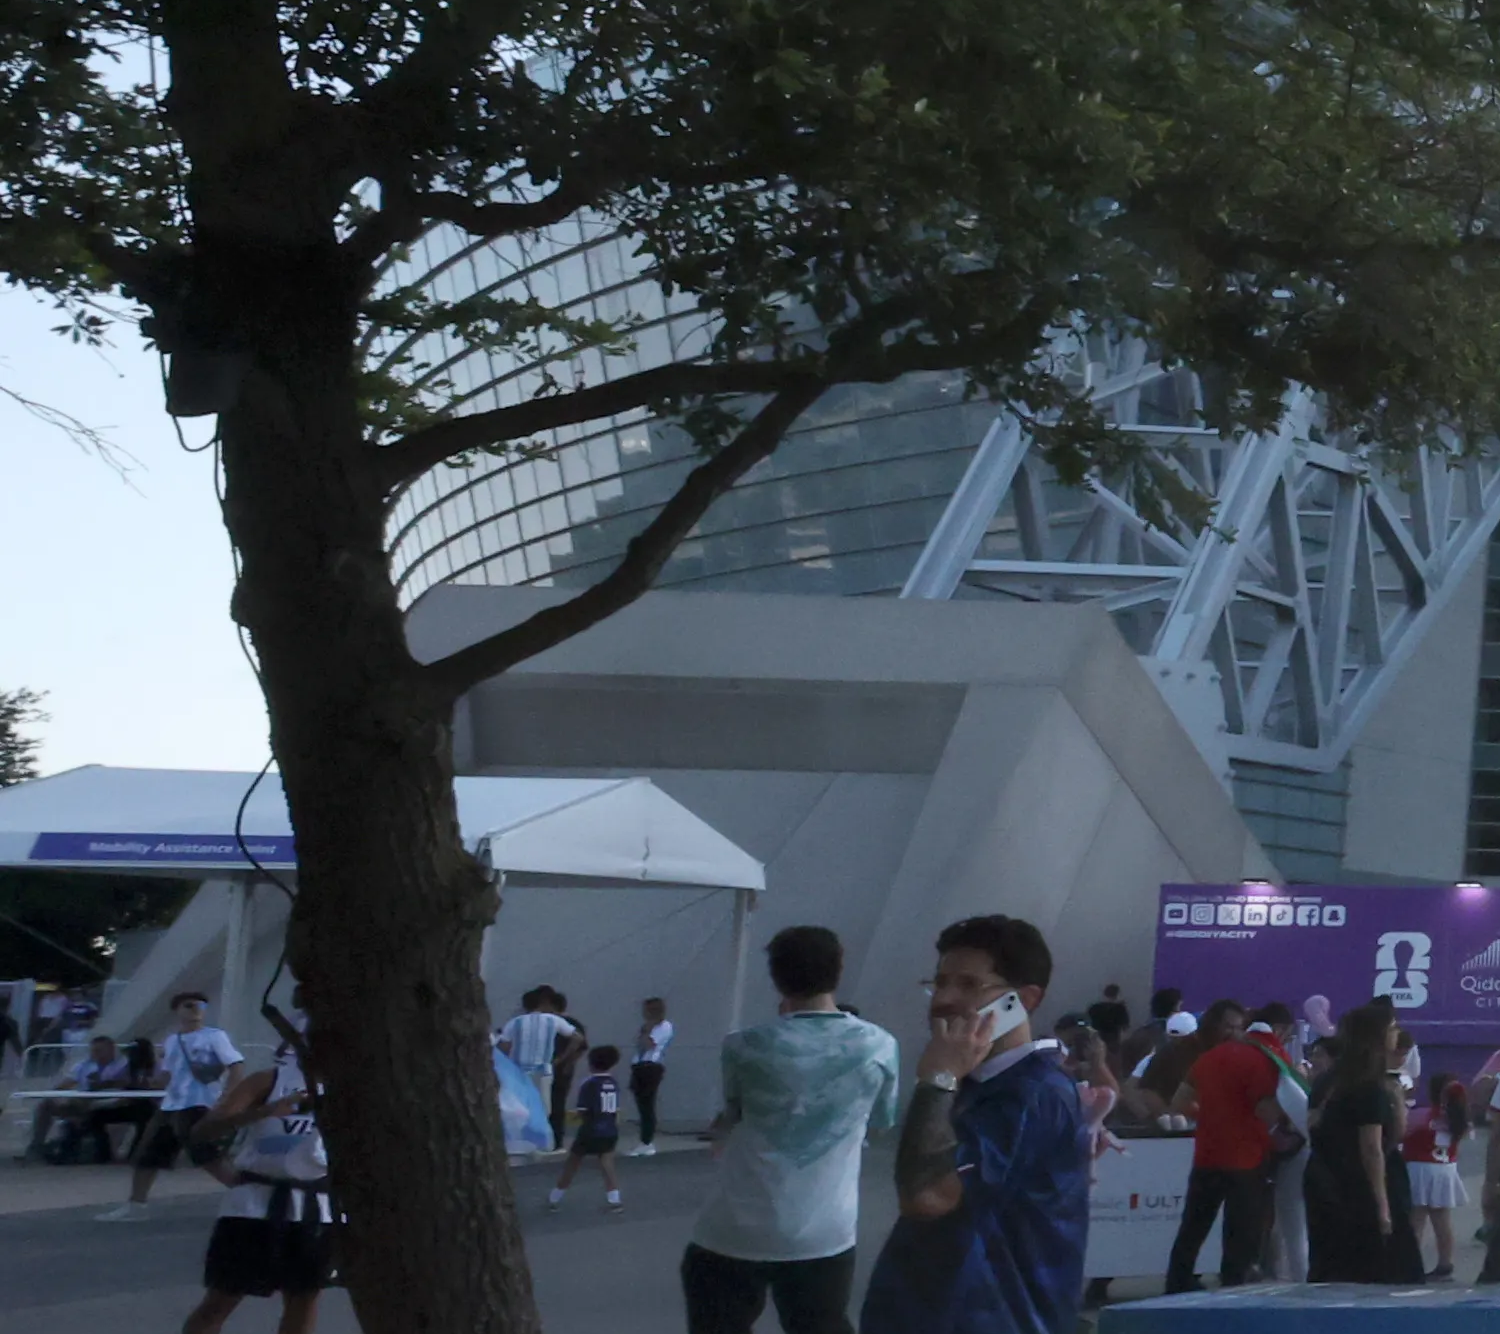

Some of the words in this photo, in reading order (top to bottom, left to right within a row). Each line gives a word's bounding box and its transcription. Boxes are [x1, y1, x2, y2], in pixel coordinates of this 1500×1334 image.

[89, 842, 151, 854] Mobility
[154, 842, 233, 854] Assistance
[600, 1092, 617, 1113] 10
[1146, 1195, 1183, 1209] ULT
